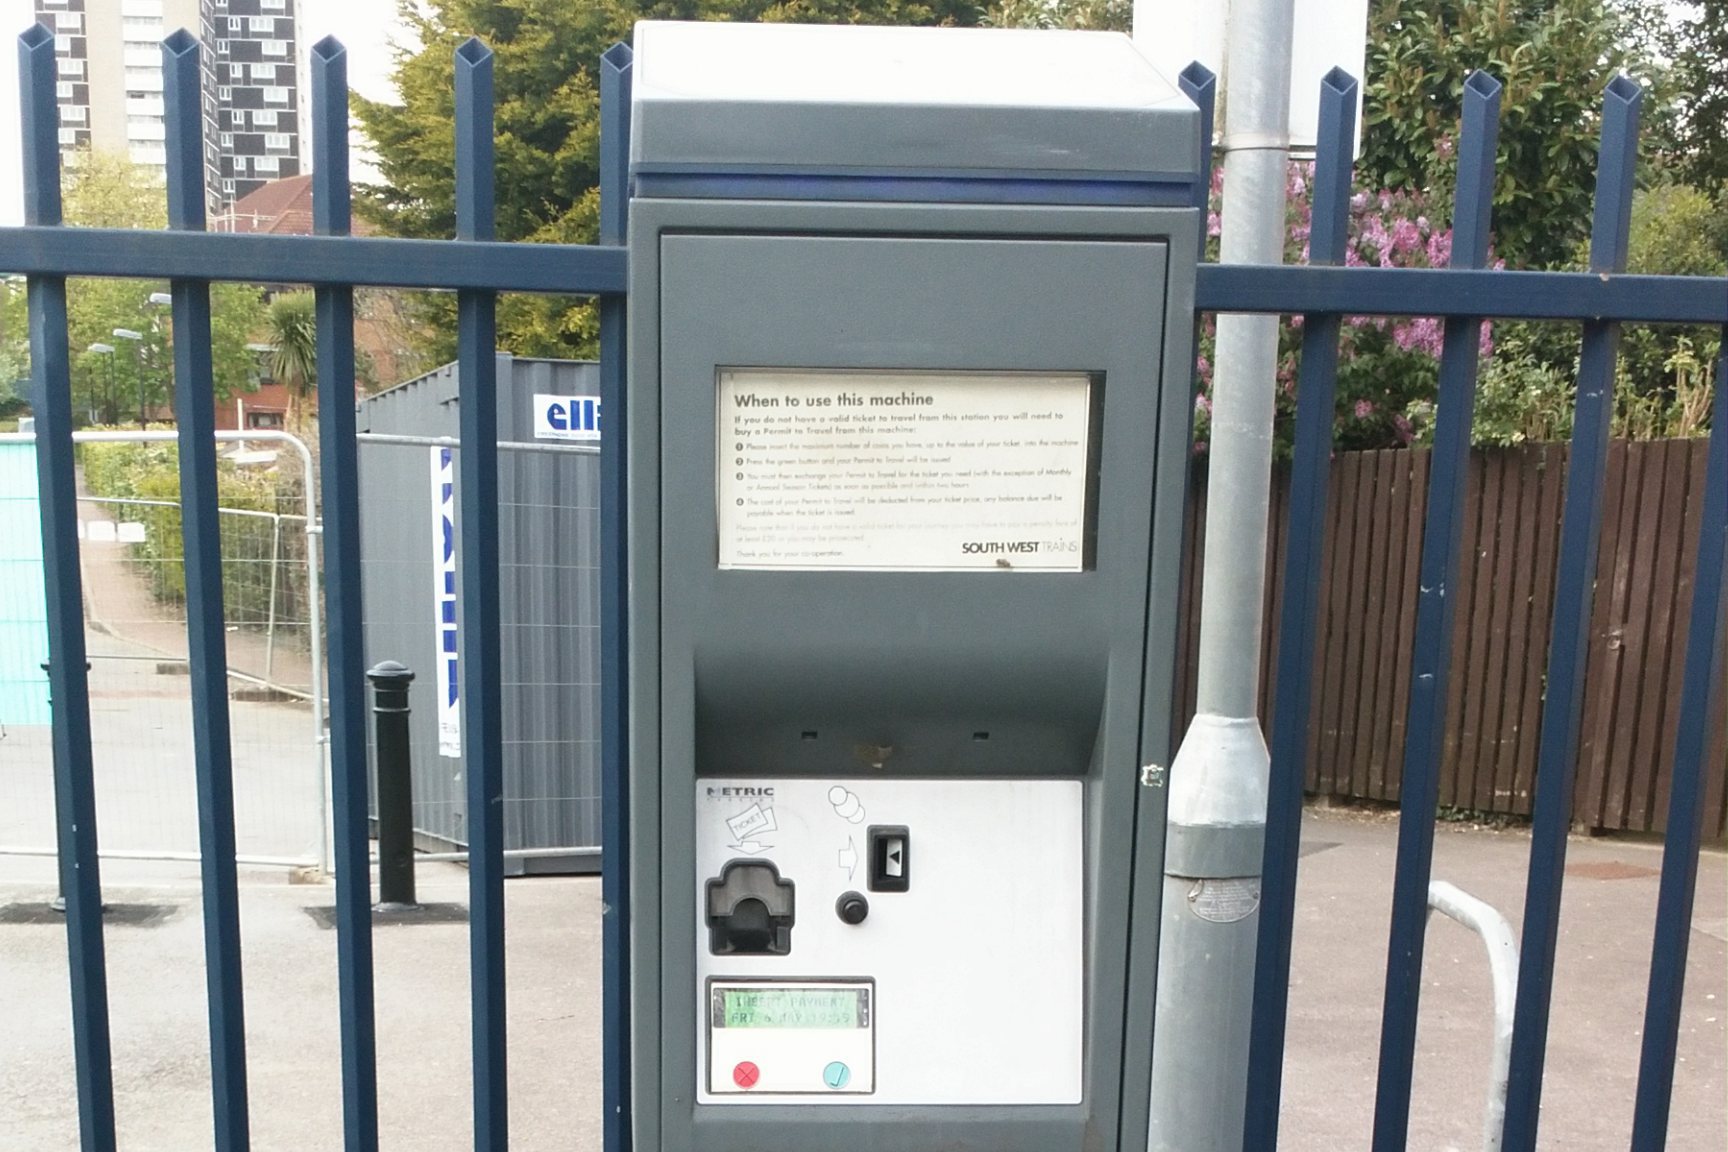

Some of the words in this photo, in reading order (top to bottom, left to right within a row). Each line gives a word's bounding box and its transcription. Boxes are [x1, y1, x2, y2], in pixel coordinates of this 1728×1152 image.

[734, 394, 779, 406] When
[785, 394, 799, 406] to
[805, 397, 831, 406] use
[837, 393, 863, 405] this
[869, 393, 933, 405] machine
[734, 415, 741, 423] If
[743, 417, 761, 425] you
[828, 414, 850, 422] valid
[918, 413, 939, 421] from
[942, 413, 957, 421] this
[1012, 412, 1028, 420] will
[1030, 412, 1052, 420] need
[734, 427, 751, 437] buy
[794, 426, 803, 434] to
[806, 426, 833, 434] Travel
[962, 543, 1004, 553] SOUTH
[1007, 542, 1039, 553] WEST
[731, 1012, 754, 1023] FRI
